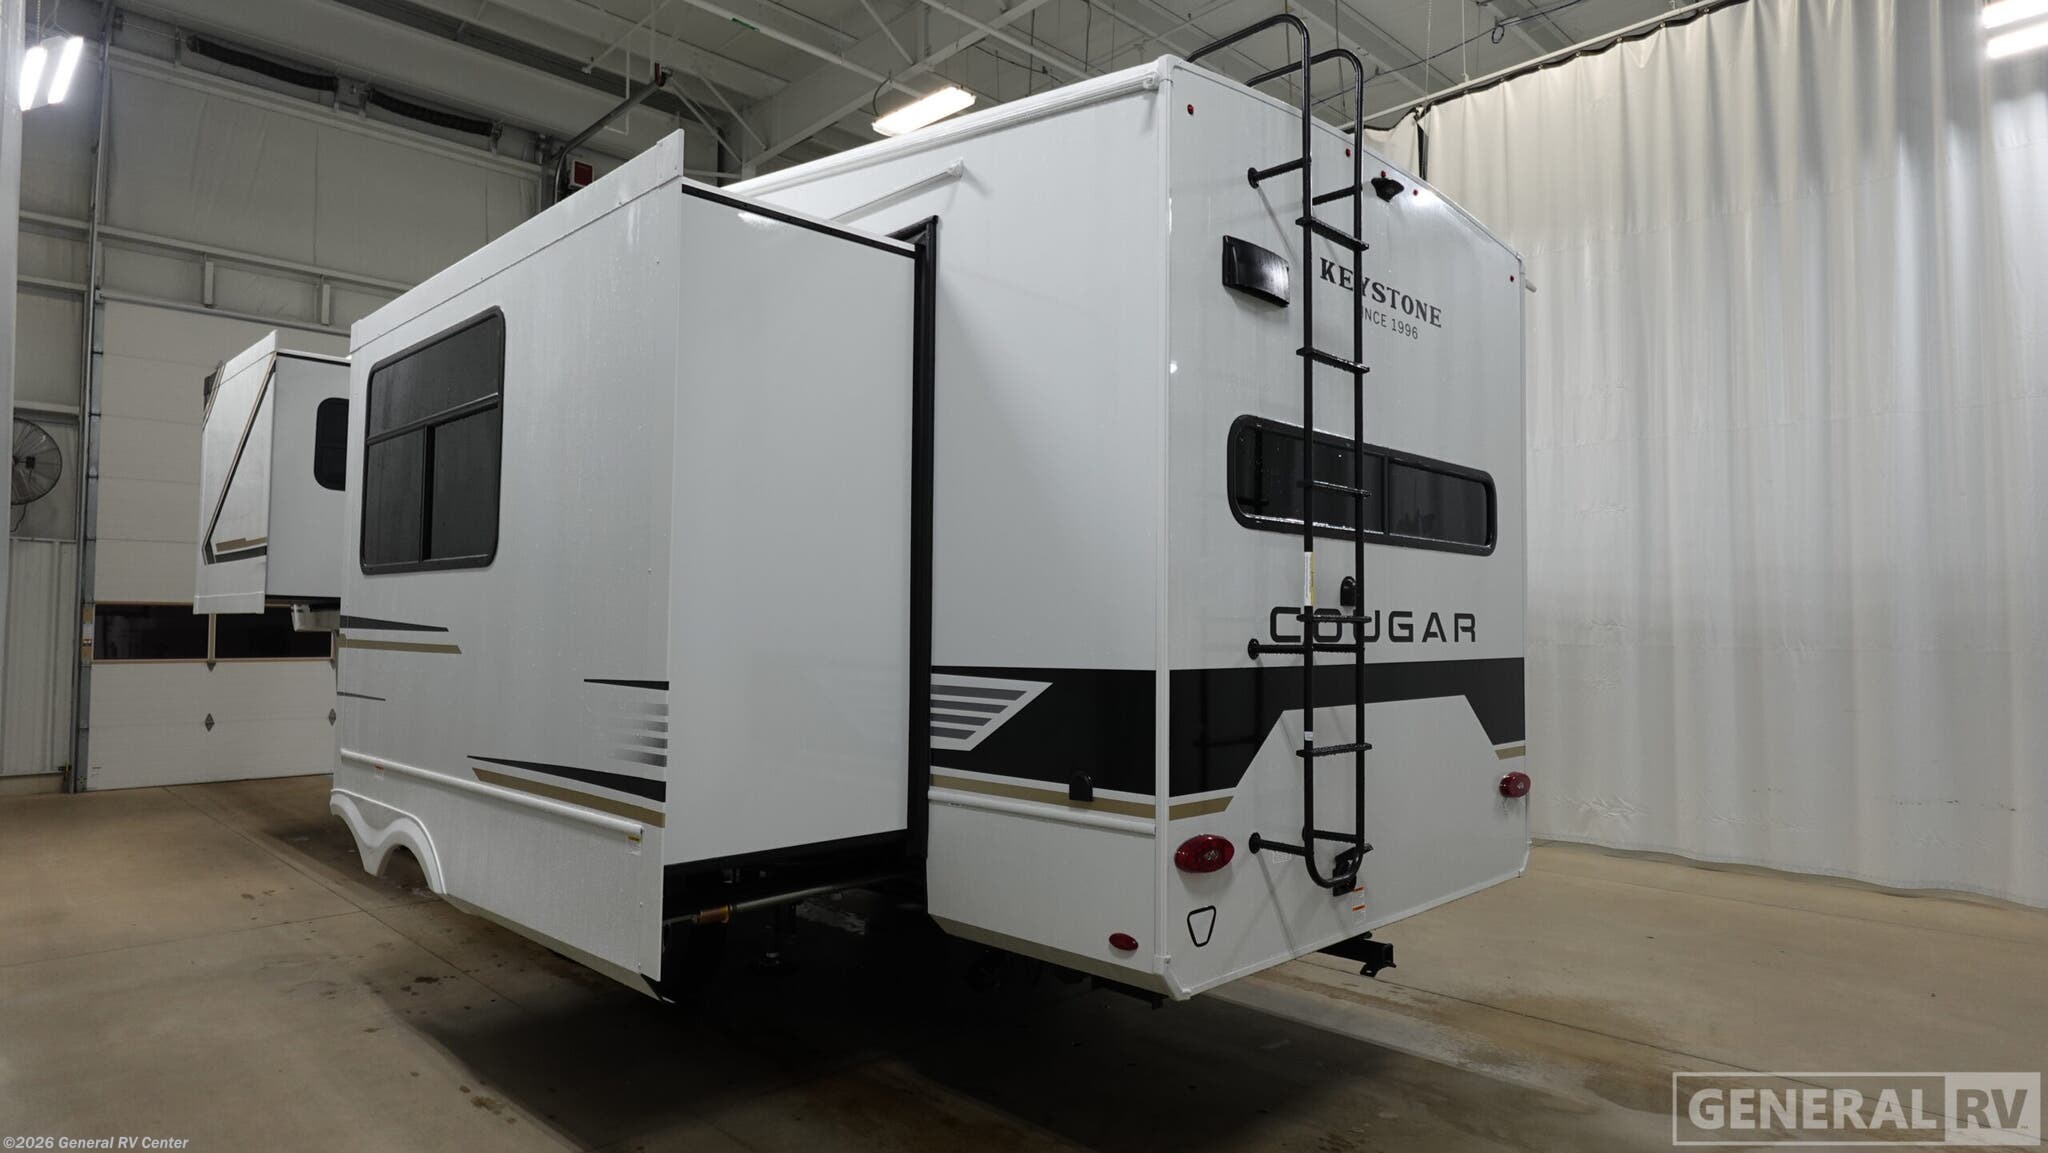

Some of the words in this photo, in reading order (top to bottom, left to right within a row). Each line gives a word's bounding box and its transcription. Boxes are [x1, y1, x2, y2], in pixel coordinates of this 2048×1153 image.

[1362, 307, 1387, 328] NCE
[1391, 318, 1419, 340] 1996
[1270, 606, 1476, 643] COUGAR
